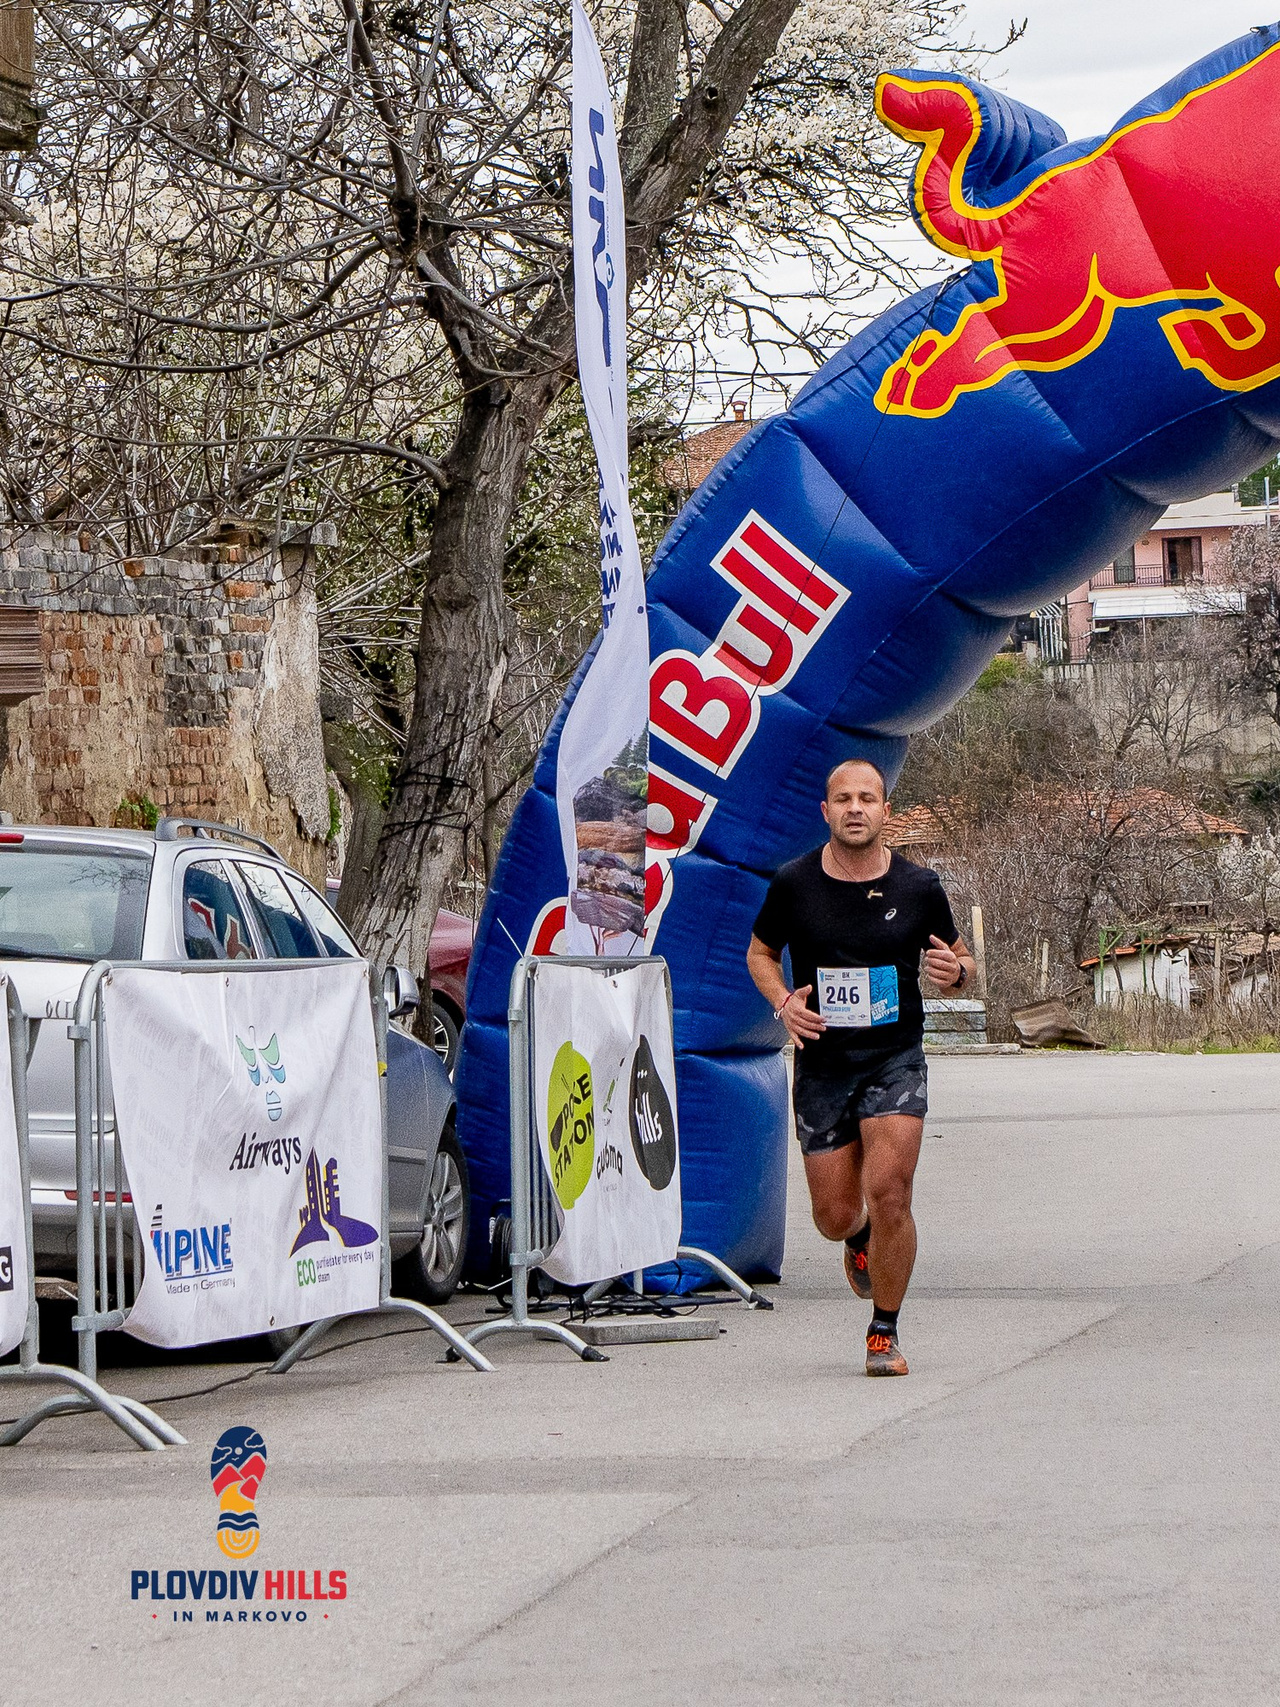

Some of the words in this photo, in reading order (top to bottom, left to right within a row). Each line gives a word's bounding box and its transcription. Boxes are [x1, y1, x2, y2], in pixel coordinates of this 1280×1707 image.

[648, 512, 846, 776] Bull
[826, 985, 860, 1005] 246
[229, 1132, 302, 1175] Airways
[296, 1257, 317, 1287] ECO
